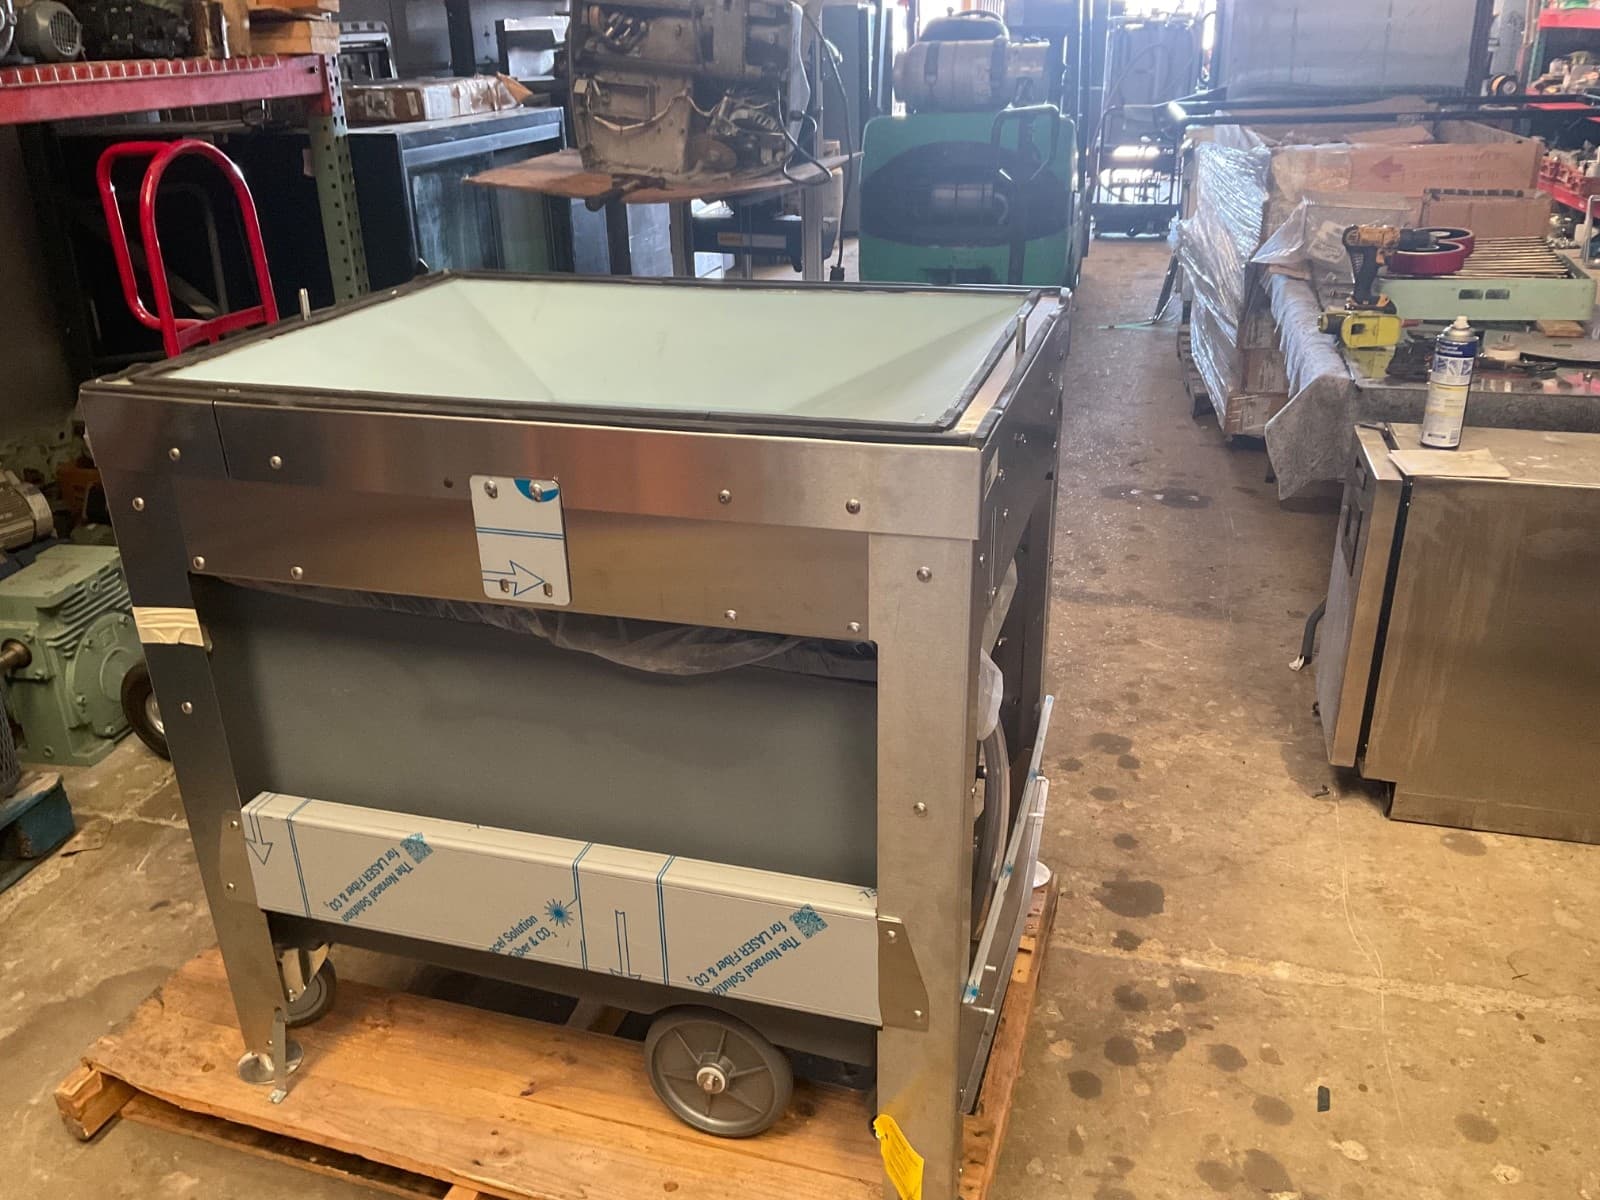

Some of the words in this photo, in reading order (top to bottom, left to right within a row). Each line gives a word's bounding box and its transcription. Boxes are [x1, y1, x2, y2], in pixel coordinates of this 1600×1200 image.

[385, 848, 400, 861] for
[362, 857, 389, 882] LASER
[395, 861, 414, 876] The
[345, 877, 367, 896] Fiber
[369, 872, 400, 902] Novacel
[339, 892, 349, 902] &
[342, 896, 373, 922] Solution
[503, 915, 538, 942] Solution
[769, 920, 787, 939] for
[528, 936, 539, 946] &
[738, 931, 773, 957] LASER
[779, 936, 801, 951] The
[716, 951, 742, 971] Fiber
[743, 947, 783, 978] Novacel
[707, 966, 719, 977] &
